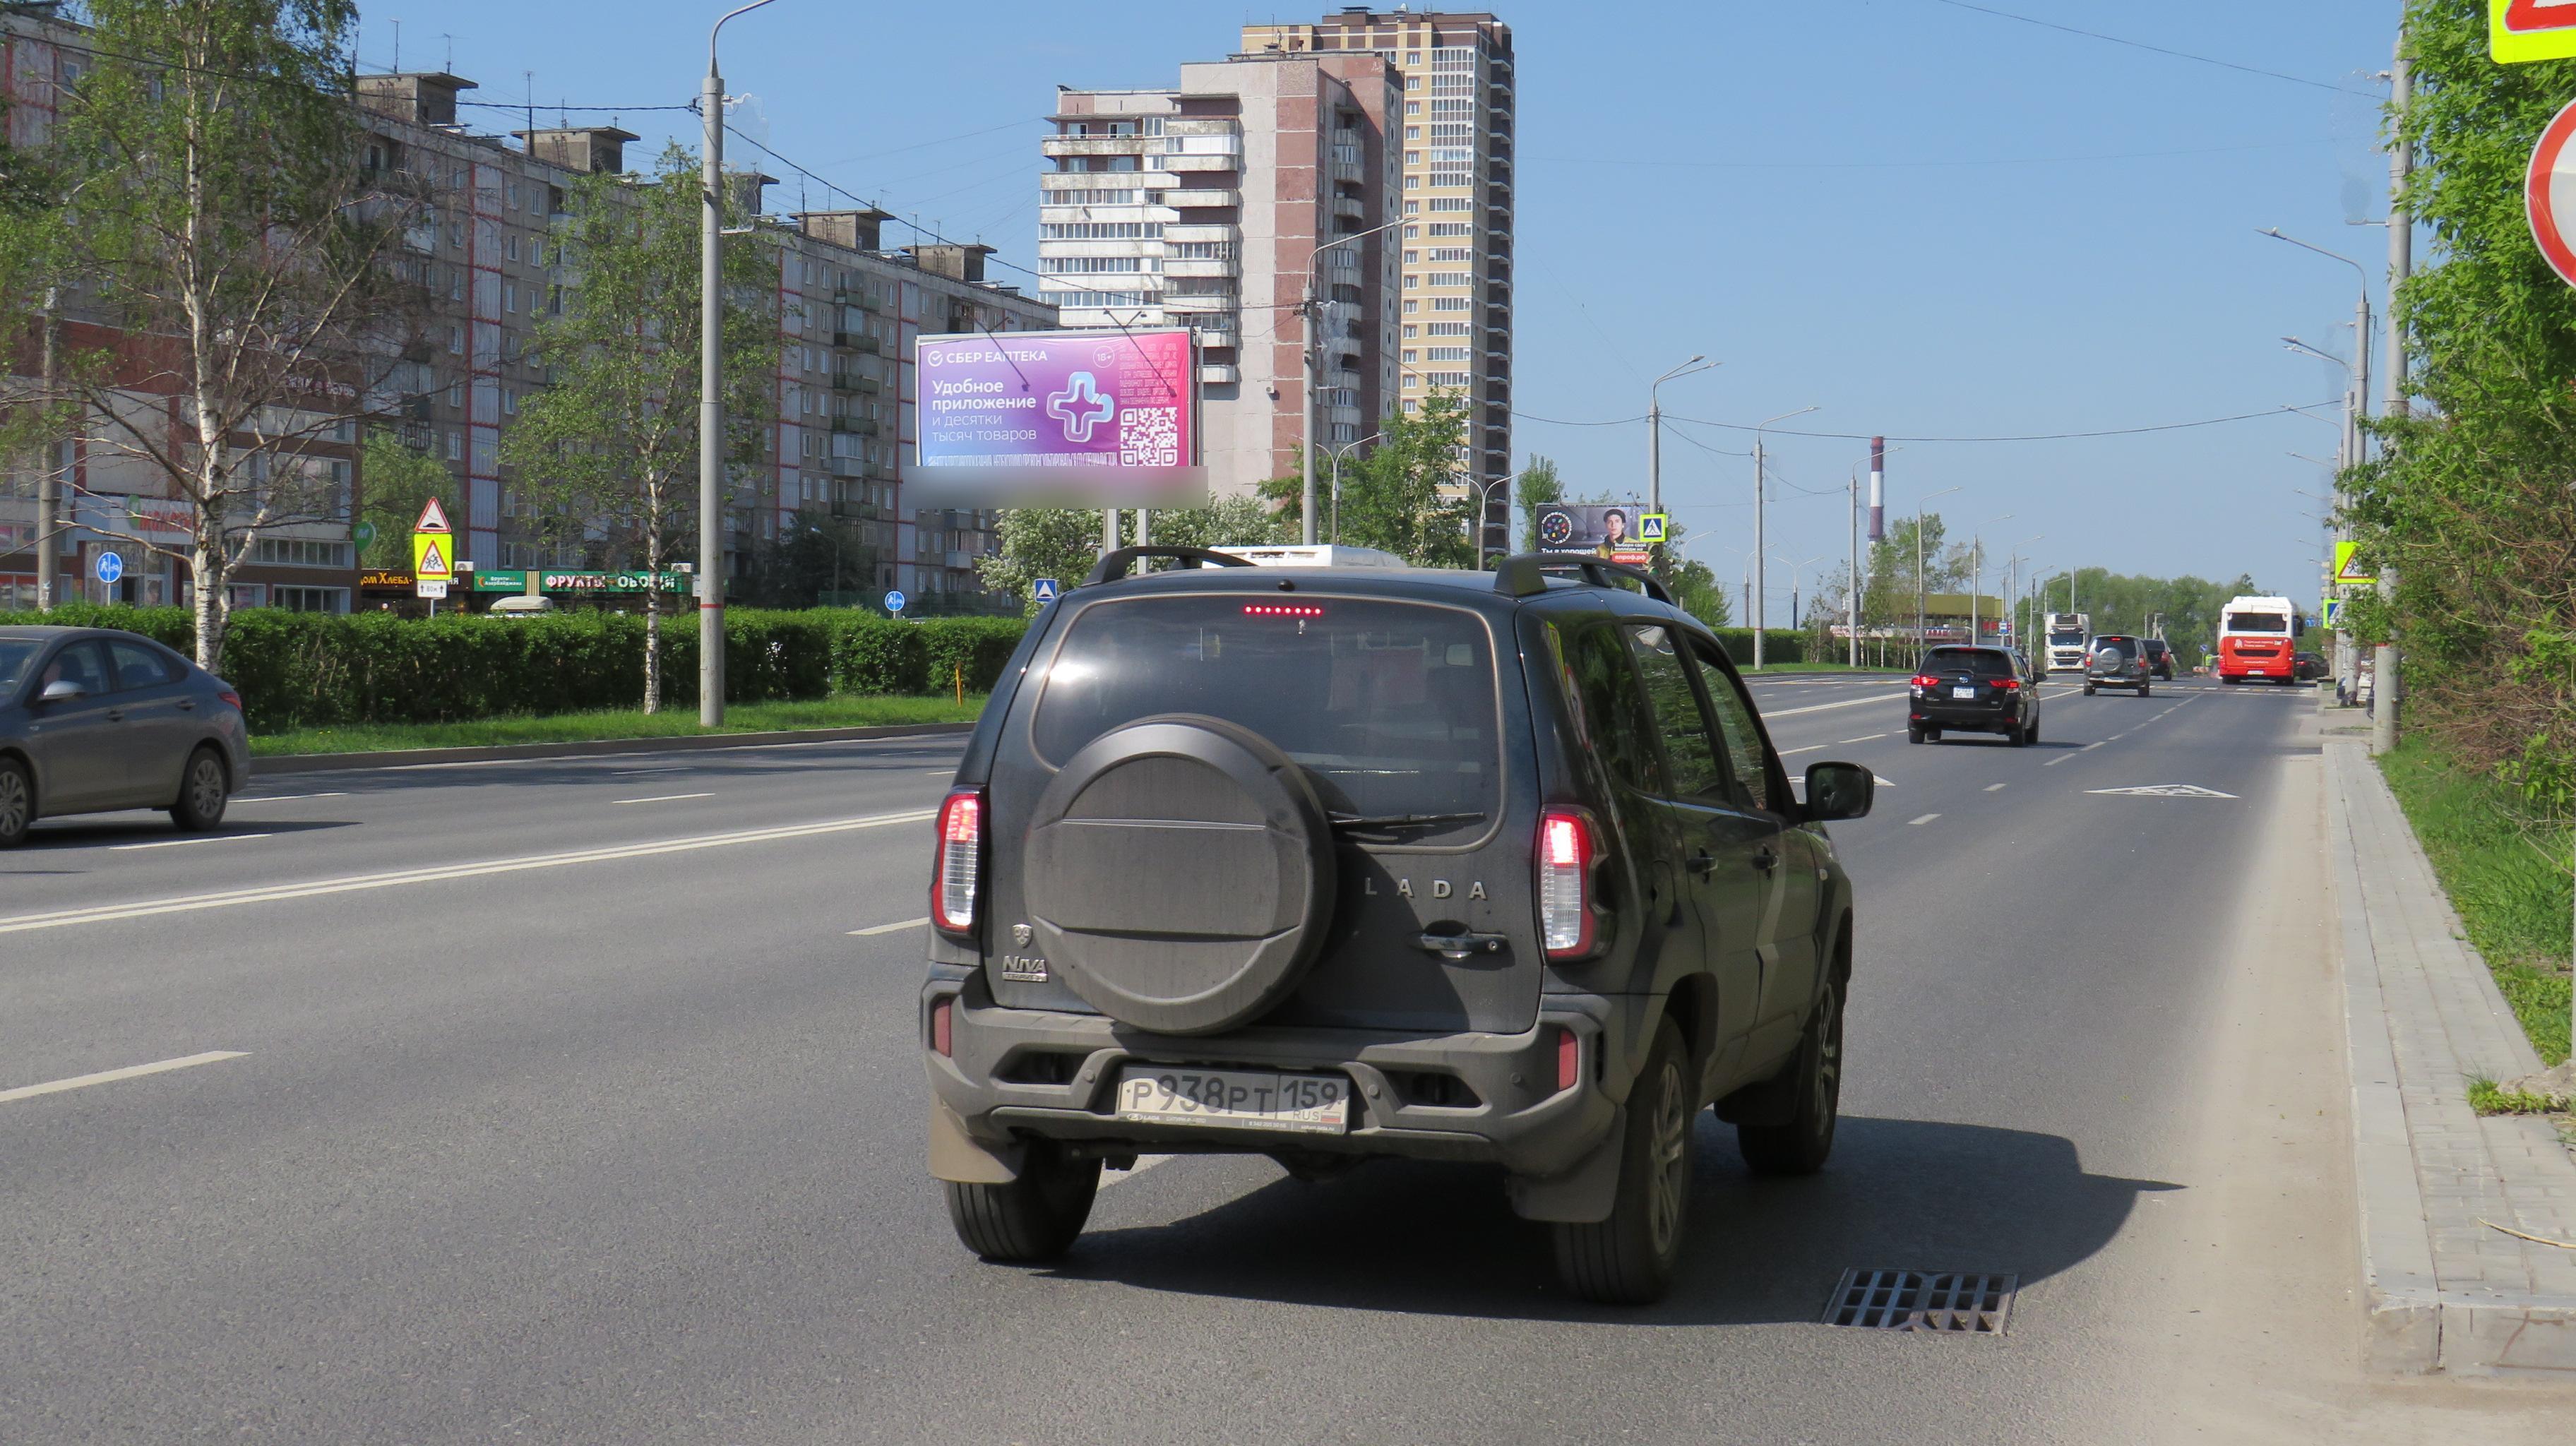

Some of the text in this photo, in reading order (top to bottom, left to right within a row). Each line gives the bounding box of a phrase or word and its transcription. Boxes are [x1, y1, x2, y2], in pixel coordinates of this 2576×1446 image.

[946, 350, 1048, 364] СБЕР ЕАПТЕКА
[1097, 353, 1112, 362] 18+
[932, 378, 1004, 396] Удобное
[932, 397, 1037, 414] приложение
[932, 415, 1003, 428] и десятки
[932, 429, 1037, 443] тысяч товаров
[1364, 877, 1487, 900] LADA
[1003, 955, 1046, 973] NIVA
[1282, 1080, 1338, 1111] 159
[1292, 1109, 1320, 1121] RUS
